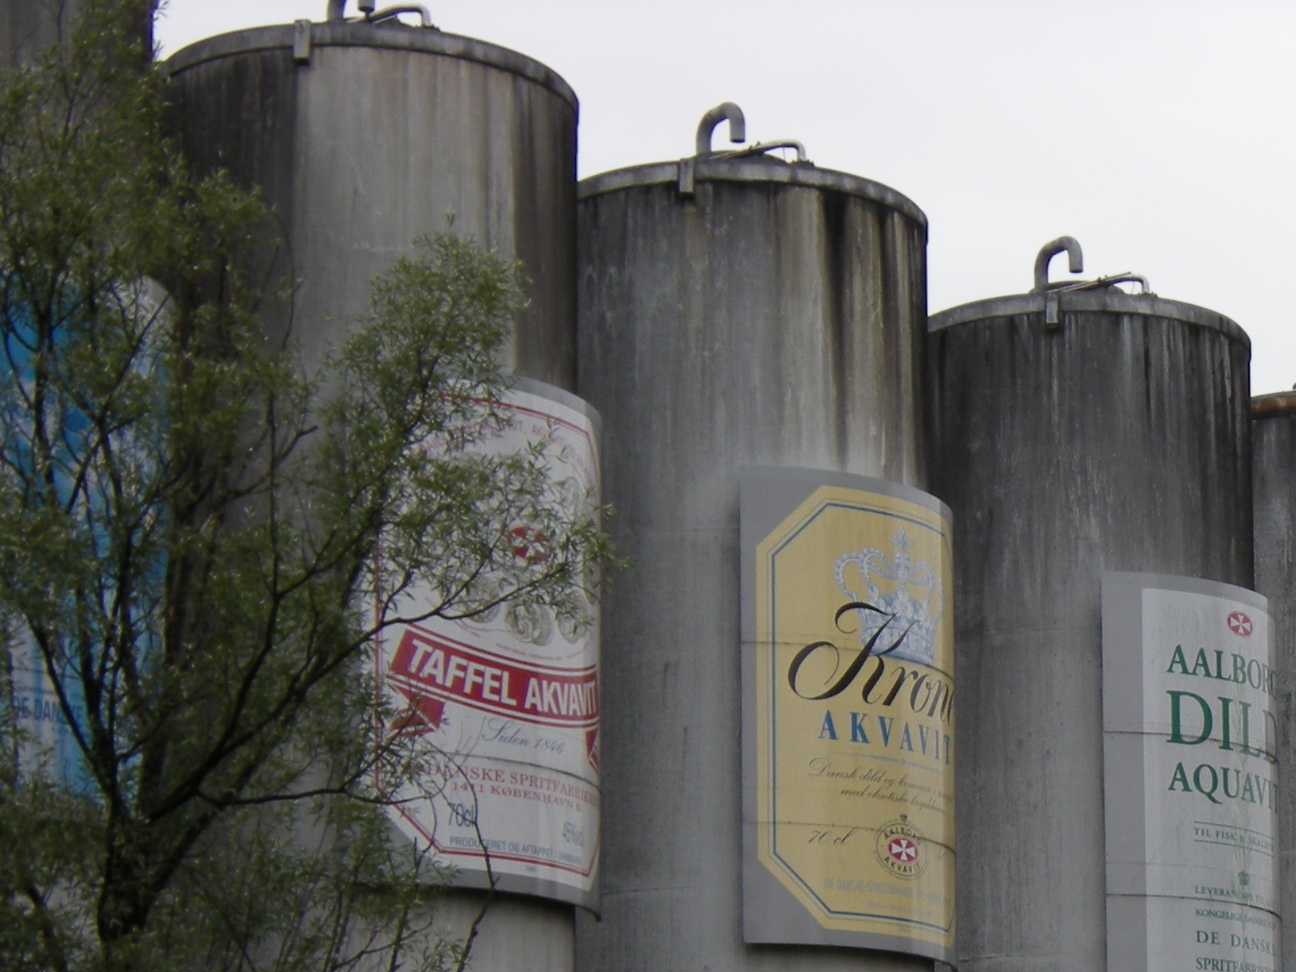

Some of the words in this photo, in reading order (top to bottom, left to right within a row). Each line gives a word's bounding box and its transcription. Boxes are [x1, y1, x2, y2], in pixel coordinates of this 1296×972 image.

[407, 639, 517, 706] TAFFEL
[524, 676, 597, 716] AKVAVIT
[482, 717, 529, 746] Siden
[818, 709, 951, 765] AKVAVIT
[1166, 690, 1277, 764] DILD
[808, 757, 856, 778] Dansk
[840, 785, 869, 797] med
[1168, 761, 1277, 813] AQUAVIT
[1193, 827, 1211, 838] TIL
[1215, 829, 1236, 841] FISK
[884, 856, 920, 873] AKVAVIT
[1195, 929, 1220, 946] DE
[1230, 933, 1276, 957] DANSKE
